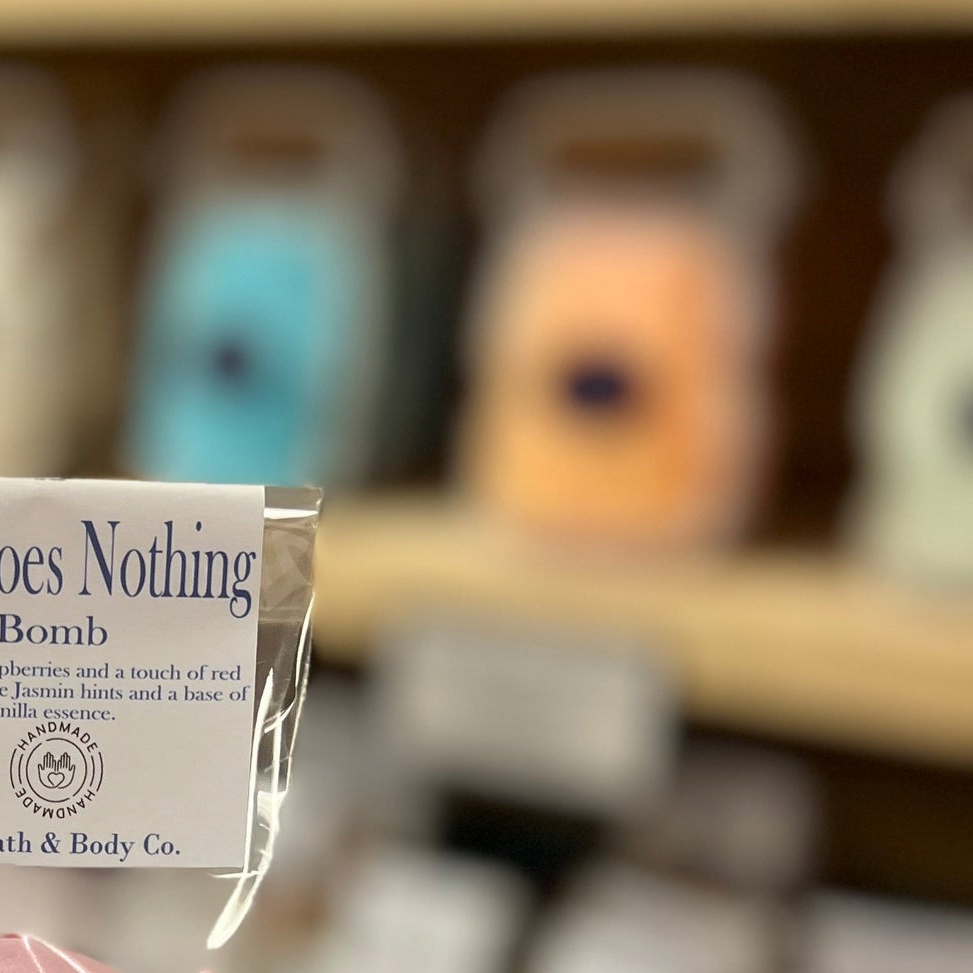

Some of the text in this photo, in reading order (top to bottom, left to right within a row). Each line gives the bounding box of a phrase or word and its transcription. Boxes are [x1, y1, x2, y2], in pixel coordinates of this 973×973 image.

[78, 519, 257, 620] Nothing
[75, 662, 110, 680] and
[115, 668, 126, 680] a
[130, 664, 182, 681] touch
[186, 664, 209, 681] of
[211, 665, 242, 682] red
[11, 681, 75, 700] Jasmin
[80, 683, 124, 701] hints
[128, 685, 163, 702] and
[167, 690, 178, 702] a
[183, 685, 224, 702] base
[228, 685, 252, 702] of
[43, 708, 116, 721] essence.
[17, 721, 99, 754] HANDMADE
[14, 787, 96, 819] HANDMADE
[40, 831, 62, 855] &
[69, 832, 135, 863] Body
[143, 833, 181, 857] Co.
